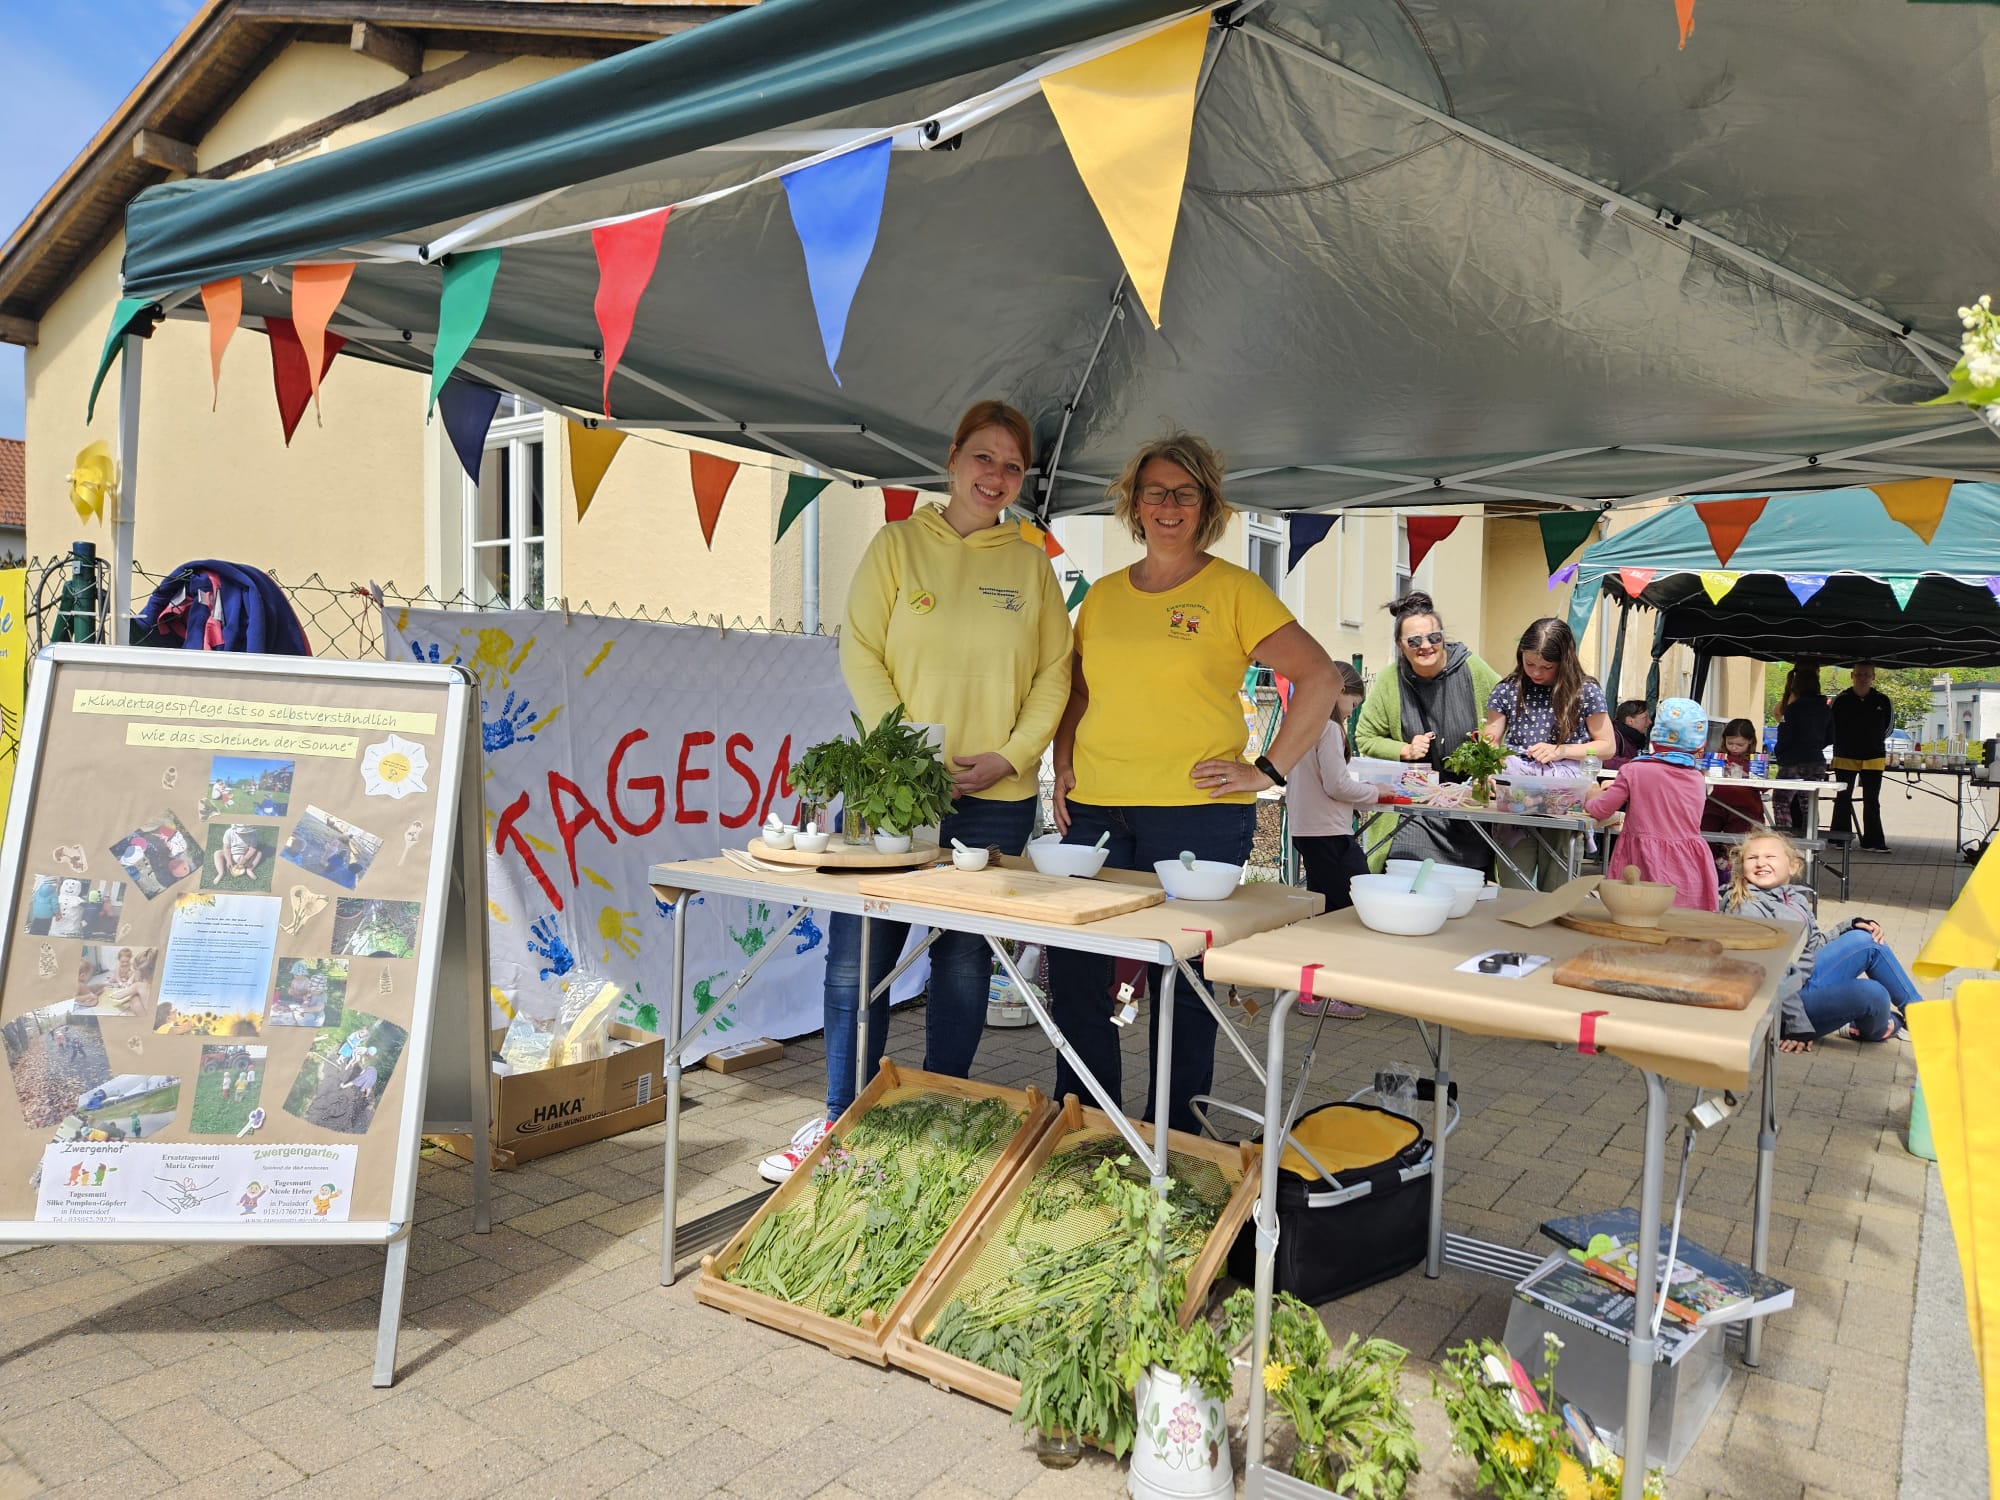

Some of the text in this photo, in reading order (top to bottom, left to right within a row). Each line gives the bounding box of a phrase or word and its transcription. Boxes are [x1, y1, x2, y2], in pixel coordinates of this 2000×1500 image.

[227, 703, 248, 716] ist
[249, 707, 265, 717] so
[268, 708, 397, 727] selbstverständlich
[169, 730, 196, 743] das
[199, 732, 270, 747] Scheinen
[273, 736, 299, 748] der
[533, 1098, 582, 1124] HAKA
[547, 1121, 562, 1131] LEBE
[252, 1147, 340, 1161] Zwergengarten
[60, 1207, 68, 1215] in
